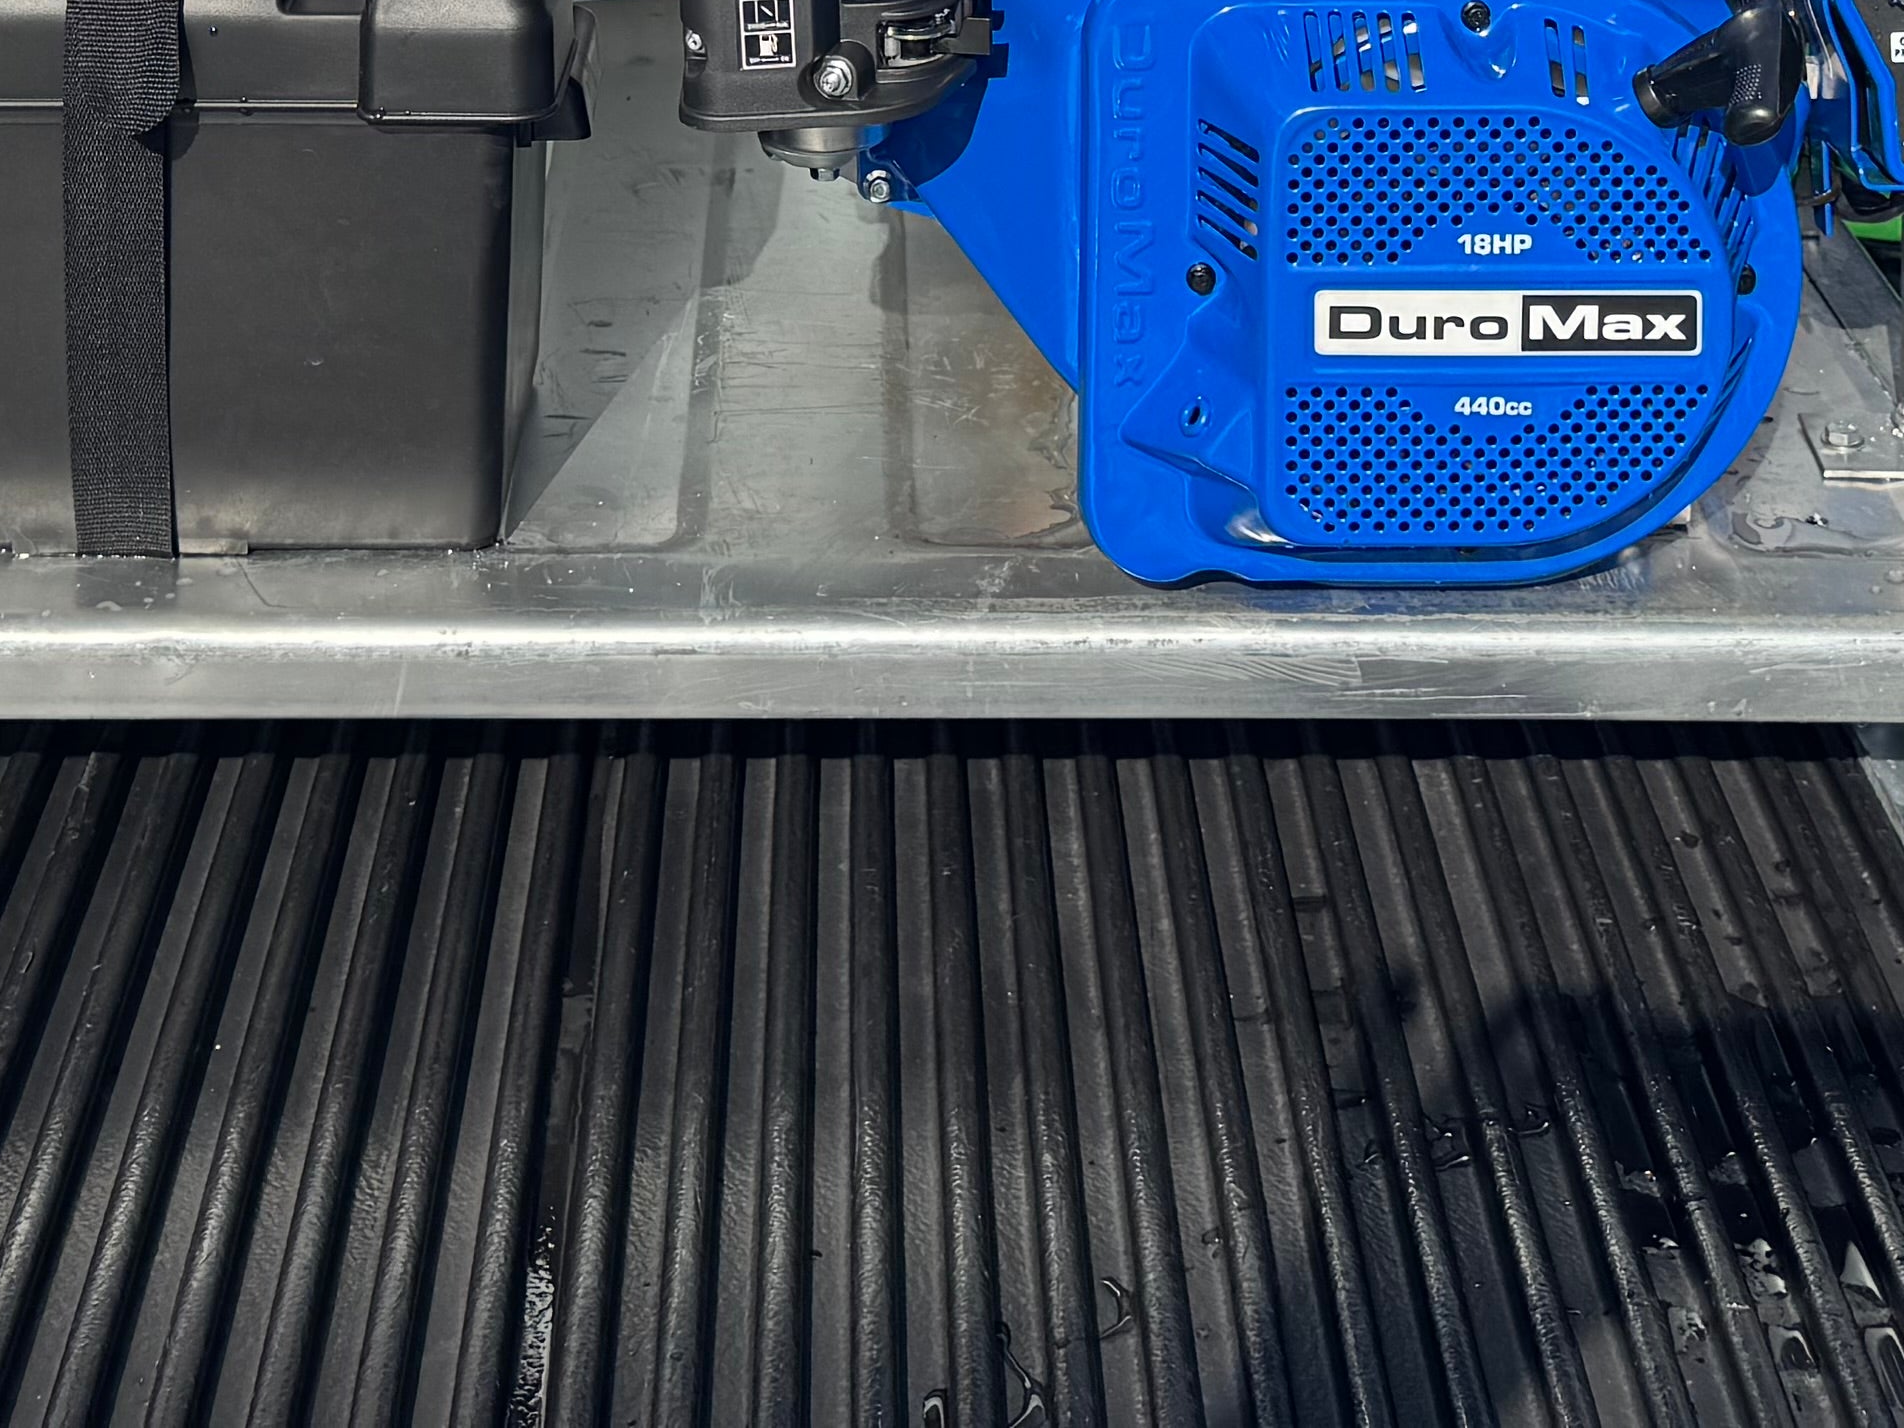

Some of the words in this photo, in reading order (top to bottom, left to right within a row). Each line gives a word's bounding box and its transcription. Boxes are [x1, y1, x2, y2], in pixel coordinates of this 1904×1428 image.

[1457, 233, 1532, 255] 18HP
[1327, 305, 1688, 342] DuroMax
[1454, 397, 1532, 416] 440cc
